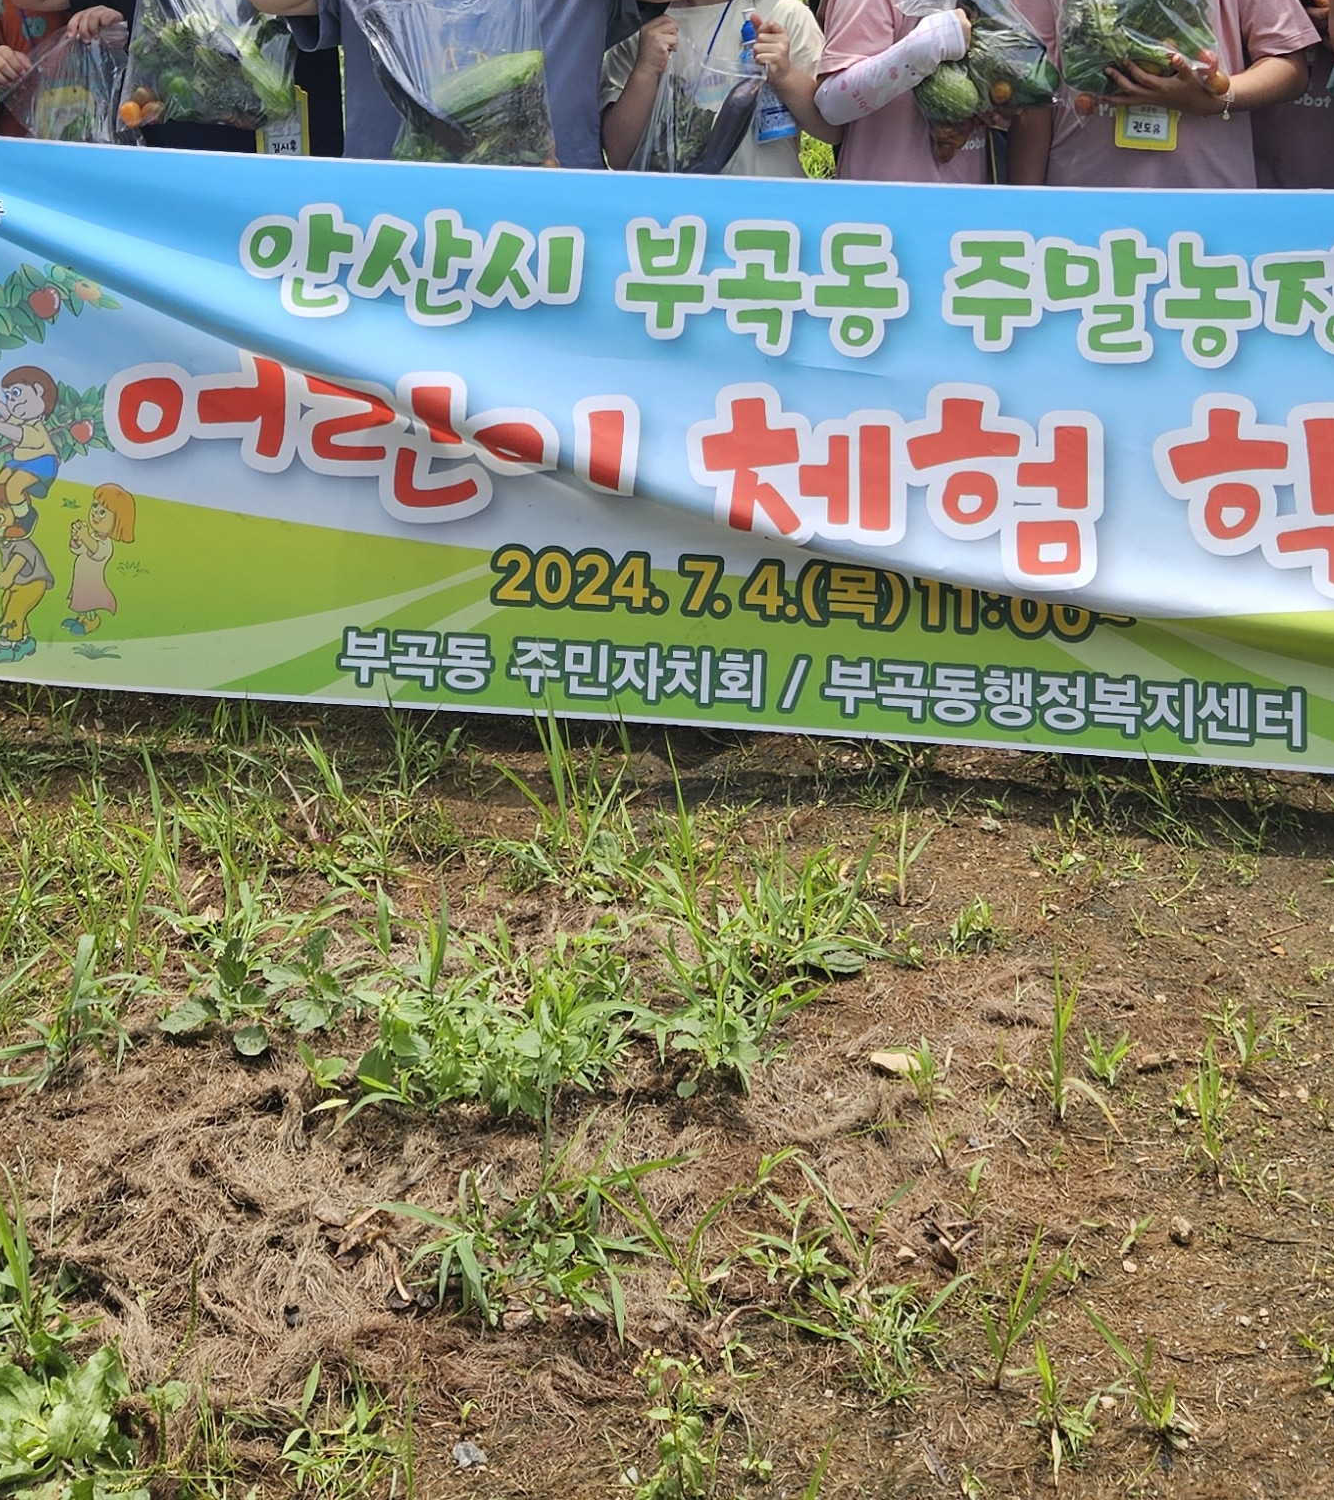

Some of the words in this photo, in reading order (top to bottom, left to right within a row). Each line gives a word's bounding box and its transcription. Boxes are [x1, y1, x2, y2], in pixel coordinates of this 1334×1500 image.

[1289, 92, 1332, 109] bot
[247, 190, 577, 318] 안산시
[623, 222, 901, 350] 부곡동
[115, 353, 627, 510] 어린이
[698, 395, 1091, 578] 체험
[491, 549, 666, 610] 2024.
[677, 558, 727, 614] 7.
[338, 629, 493, 691] 부곡동
[509, 638, 764, 709] 주민자치회
[823, 658, 1305, 750] 부곡동행정복지센터
